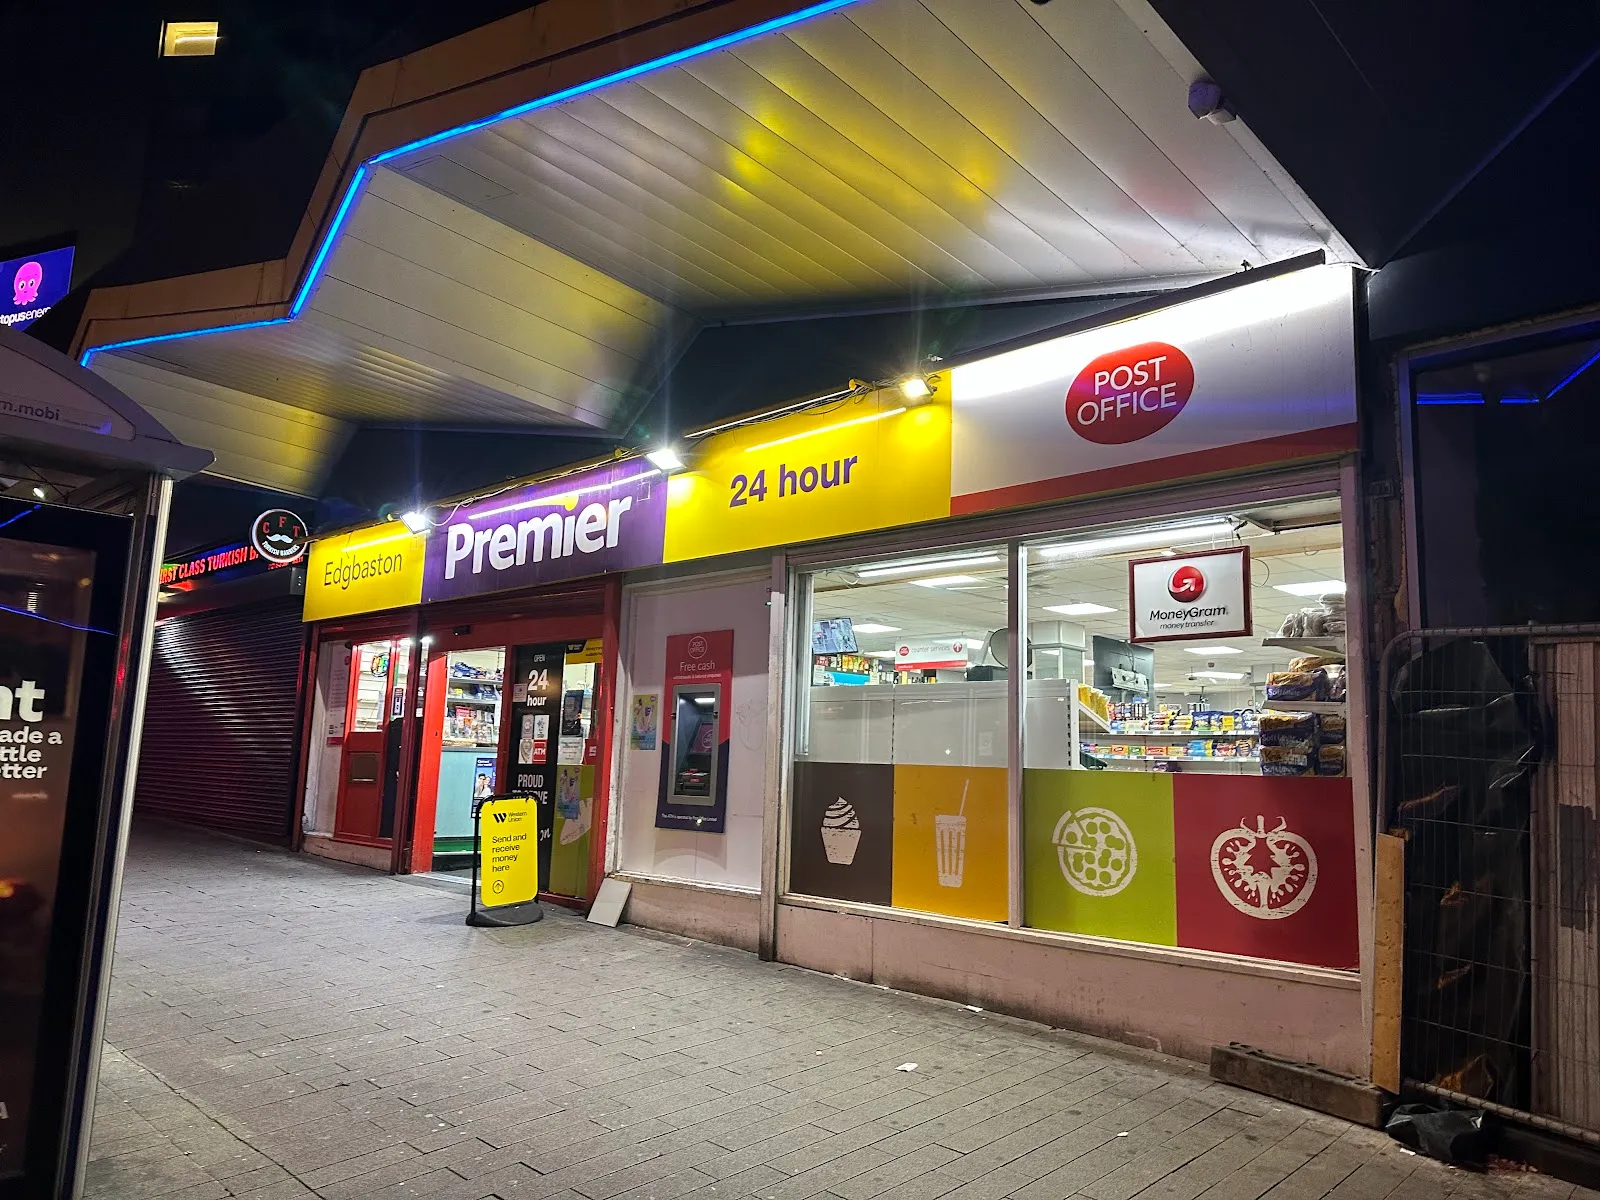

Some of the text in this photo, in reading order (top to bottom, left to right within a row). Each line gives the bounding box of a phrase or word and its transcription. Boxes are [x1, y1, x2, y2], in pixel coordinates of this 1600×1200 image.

[1093, 355, 1168, 398] POST
[1077, 381, 1178, 427] OFFICE
[729, 455, 859, 508] 24 hour
[444, 494, 632, 580] Premier
[178, 558, 206, 579] CLASS
[207, 546, 248, 572] TURKISH
[324, 552, 403, 590] Edgbaston
[1149, 606, 1227, 621] MoneyGram
[1160, 619, 1214, 630] money transfer
[680, 660, 716, 672] Free cash
[528, 669, 549, 691] 24
[527, 694, 547, 707] hour
[47, 731, 63, 745] a
[0, 763, 48, 779] tter
[517, 774, 544, 788] PROUD
[492, 832, 527, 844] Send and
[492, 844, 520, 854] receive
[492, 854, 518, 863] money
[492, 864, 510, 873] here
